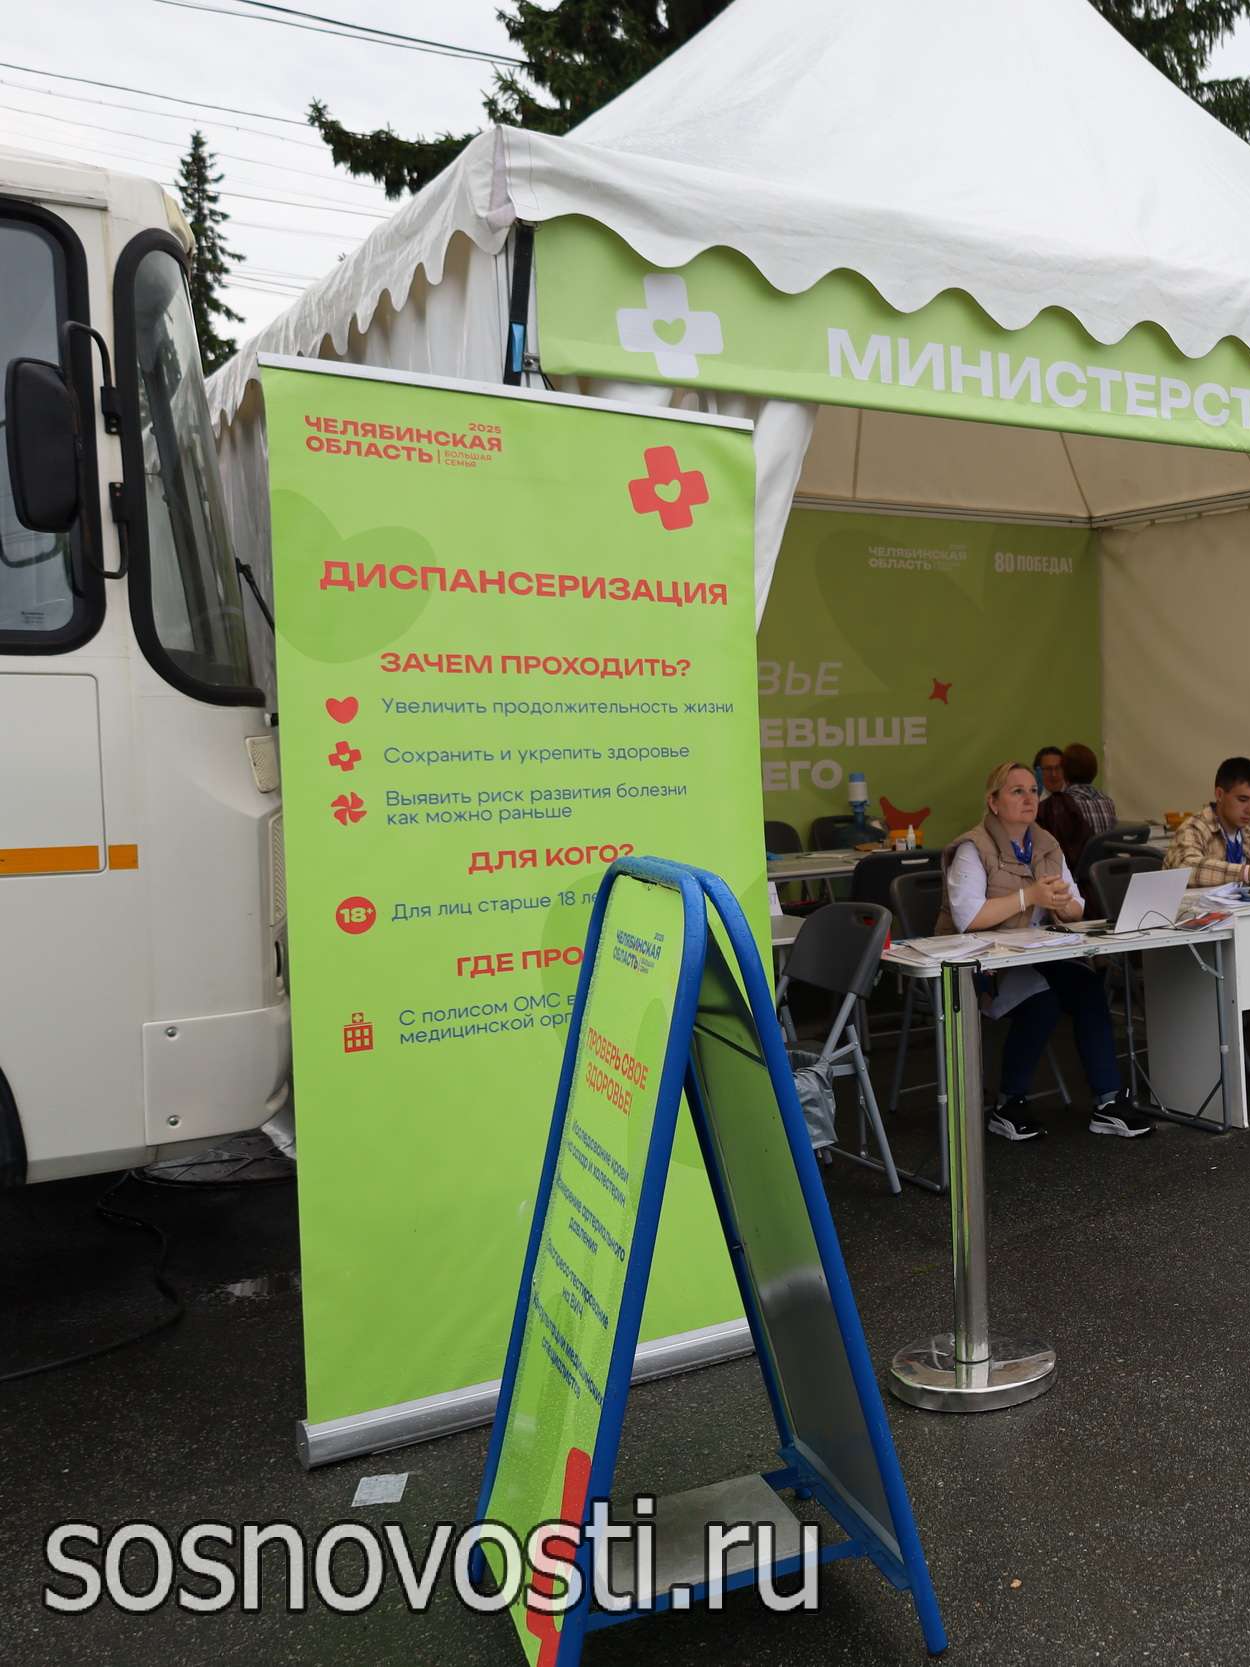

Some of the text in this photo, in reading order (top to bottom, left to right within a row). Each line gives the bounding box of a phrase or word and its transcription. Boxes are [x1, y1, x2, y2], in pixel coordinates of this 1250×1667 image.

[304, 415, 503, 452] ЧЕЛЯБИНСКАЯ
[468, 422, 502, 434] 2025
[305, 435, 433, 464] ОБЛАСТЬ
[868, 558, 932, 571] ОБЛАСТЬ
[994, 551, 1073, 575] 80 ПОБЕДА!
[319, 560, 728, 607] ДИСПАНСЕРИЗАЦИЯ
[380, 652, 691, 679] ЗАЧЕМ ПРОХОДИТЬ?
[382, 697, 734, 717] Увеличить продолжительность жизни
[760, 716, 928, 748] ЕВЫШЕ
[384, 745, 690, 766] Сохранить и укрепить здоровье
[763, 759, 843, 791] ЕГО
[386, 783, 687, 806] Выявить риск развития болезни
[387, 805, 572, 825] как можно раньше
[467, 843, 634, 875] ДЛЯ КОГО?
[339, 905, 374, 923] 18+
[391, 891, 599, 922] Для лиц старше 18 ле
[456, 946, 584, 978] ГДЕ ПРО
[399, 1009, 416, 1026] С
[422, 1003, 508, 1023] полисом
[514, 992, 561, 1012] ОМС
[400, 1012, 573, 1045] медицинской орг
[586, 1026, 649, 1091] ПРОВЕРЬ СВОЕ
[585, 1060, 633, 1117] ЗДОРОВЬЕ!
